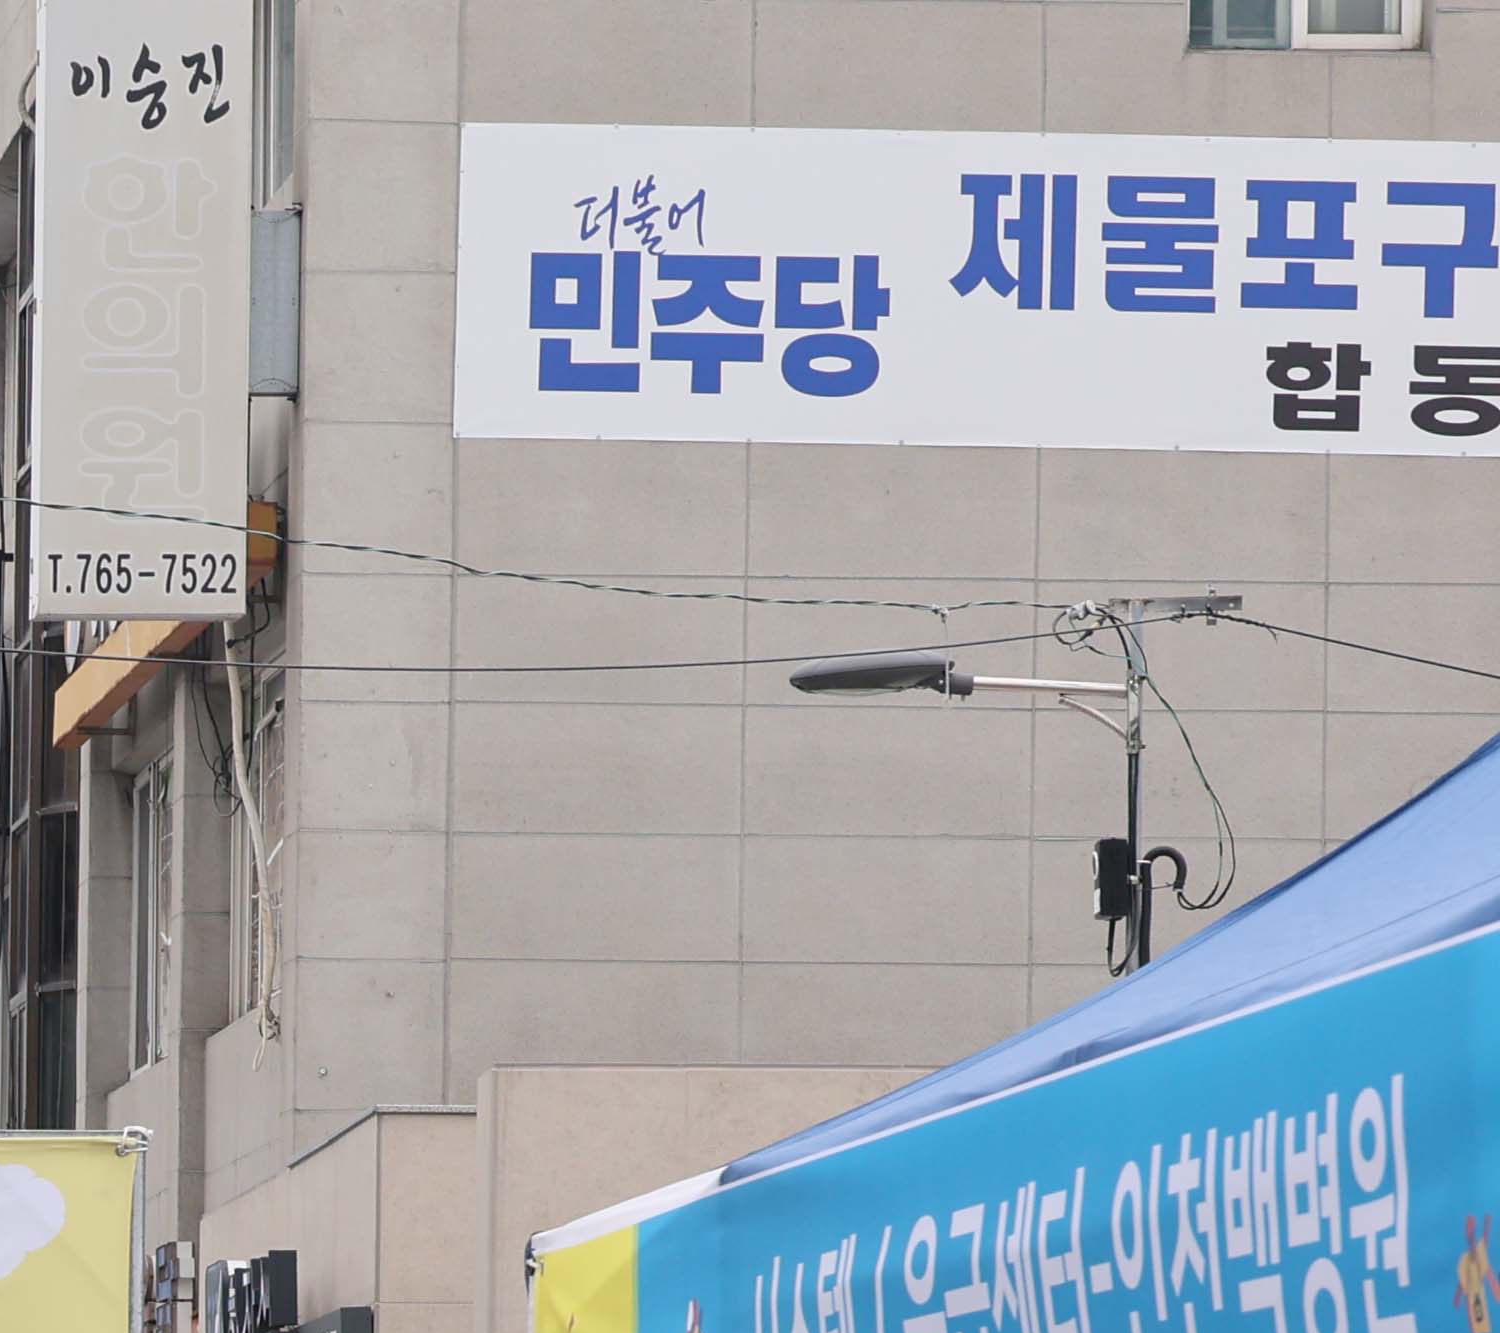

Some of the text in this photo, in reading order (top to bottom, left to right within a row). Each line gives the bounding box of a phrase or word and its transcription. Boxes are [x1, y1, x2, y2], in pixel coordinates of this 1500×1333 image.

[70, 43, 231, 131] 이승진
[574, 172, 707, 256] 더불어
[950, 172, 1500, 320] 제물포구
[528, 250, 892, 398] 민주당
[48, 552, 239, 596] T.765-7522
